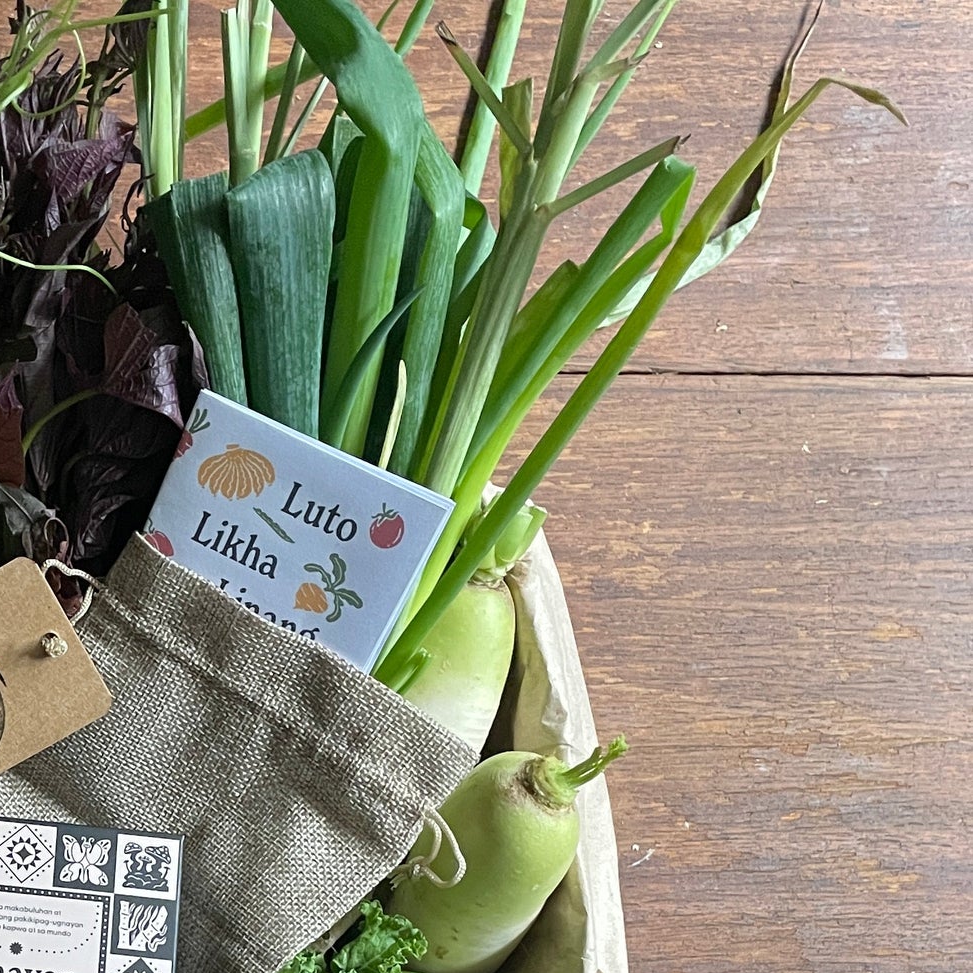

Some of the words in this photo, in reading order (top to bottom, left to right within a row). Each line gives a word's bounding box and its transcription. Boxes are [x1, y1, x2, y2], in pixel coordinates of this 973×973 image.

[281, 481, 358, 542] Luto
[190, 511, 279, 579] Likha
[4, 904, 53, 915] makabuluhan
[13, 915, 84, 929] pakikipag-ugnayan
[3, 923, 27, 932] kapwa
[47, 929, 72, 937] mundo
